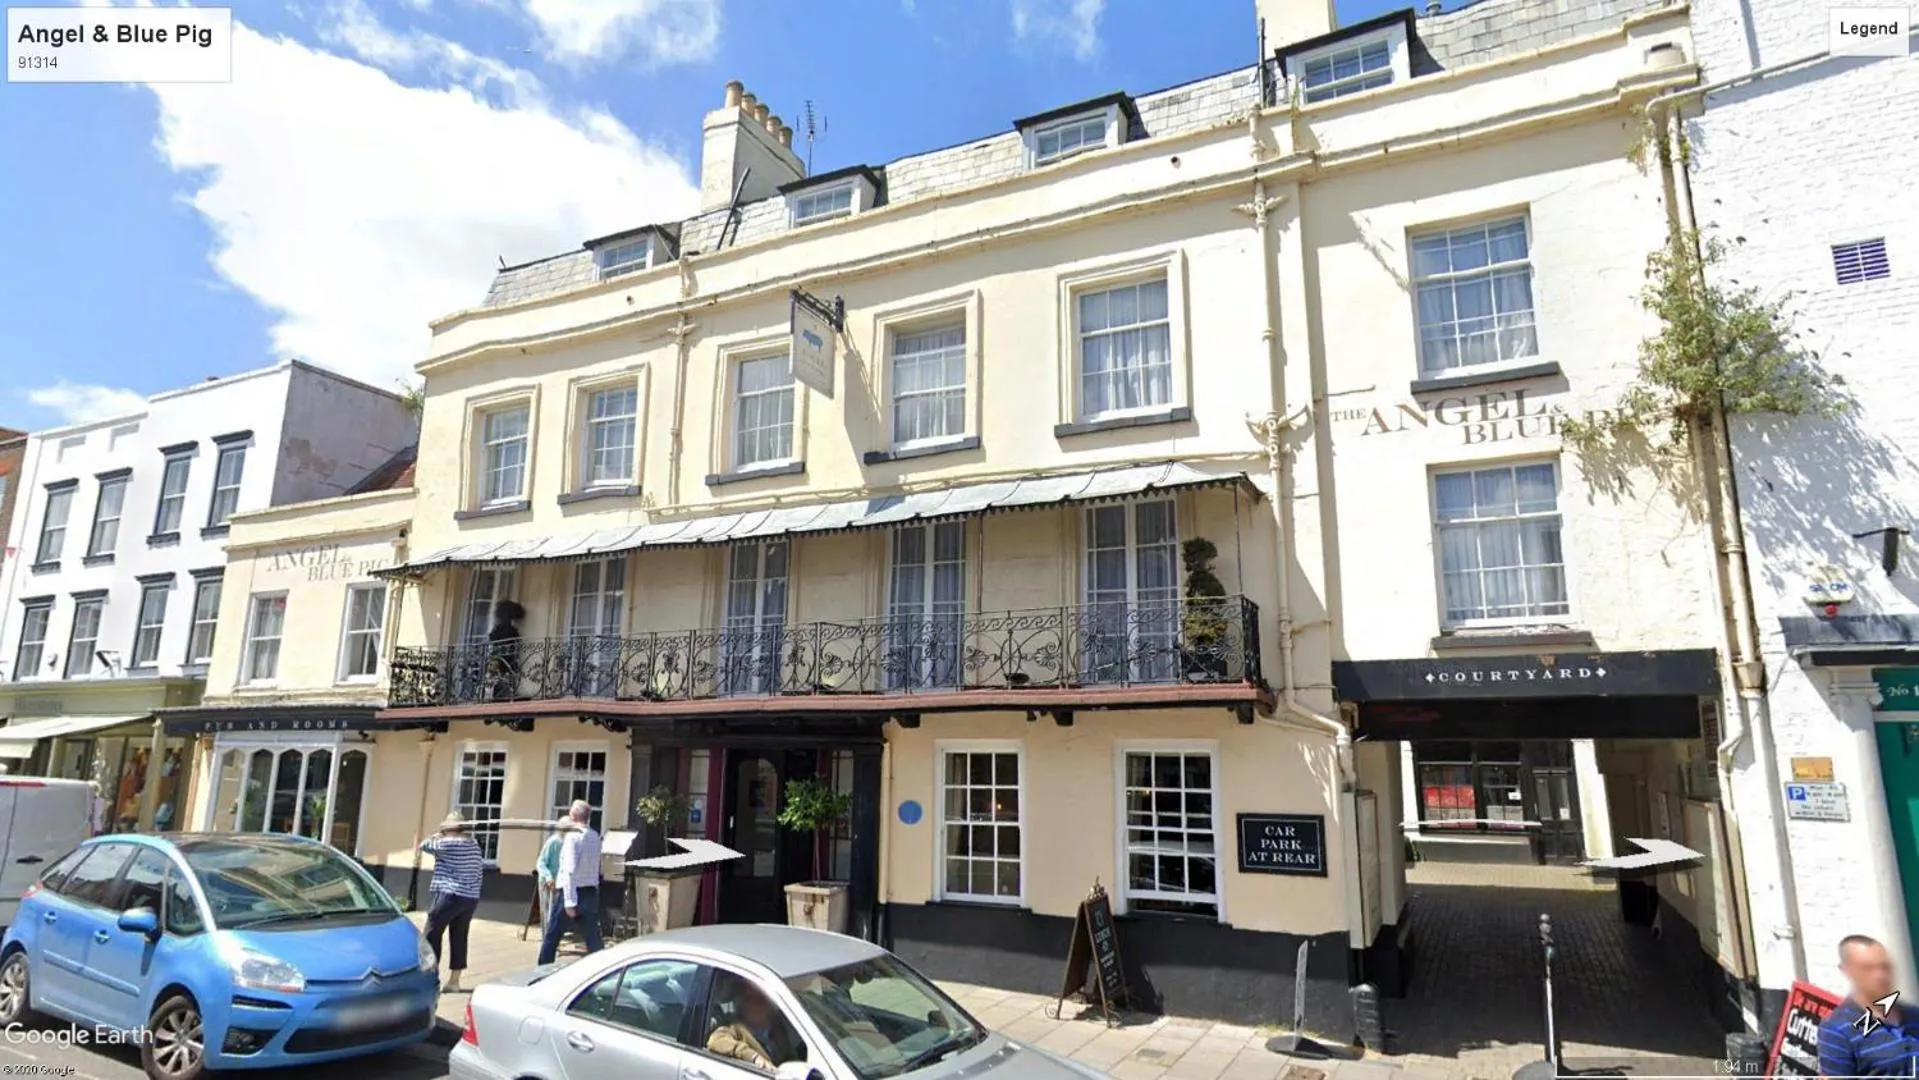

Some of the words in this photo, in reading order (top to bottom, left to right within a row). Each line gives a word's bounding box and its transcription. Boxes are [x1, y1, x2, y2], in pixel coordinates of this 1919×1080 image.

[1330, 407, 1367, 422] THE
[1361, 387, 1547, 436] ANGEL
[266, 544, 341, 572] ANGEL
[308, 560, 355, 581] BLUE
[1438, 667, 1591, 683] COURTYARD
[204, 722, 233, 730] PUB
[248, 721, 278, 729] AND
[293, 720, 348, 729] ROOMS
[1264, 825, 1296, 837] CAR
[1260, 838, 1302, 850] PARK
[1248, 851, 1268, 862] AT
[1272, 853, 1316, 865] REAR
